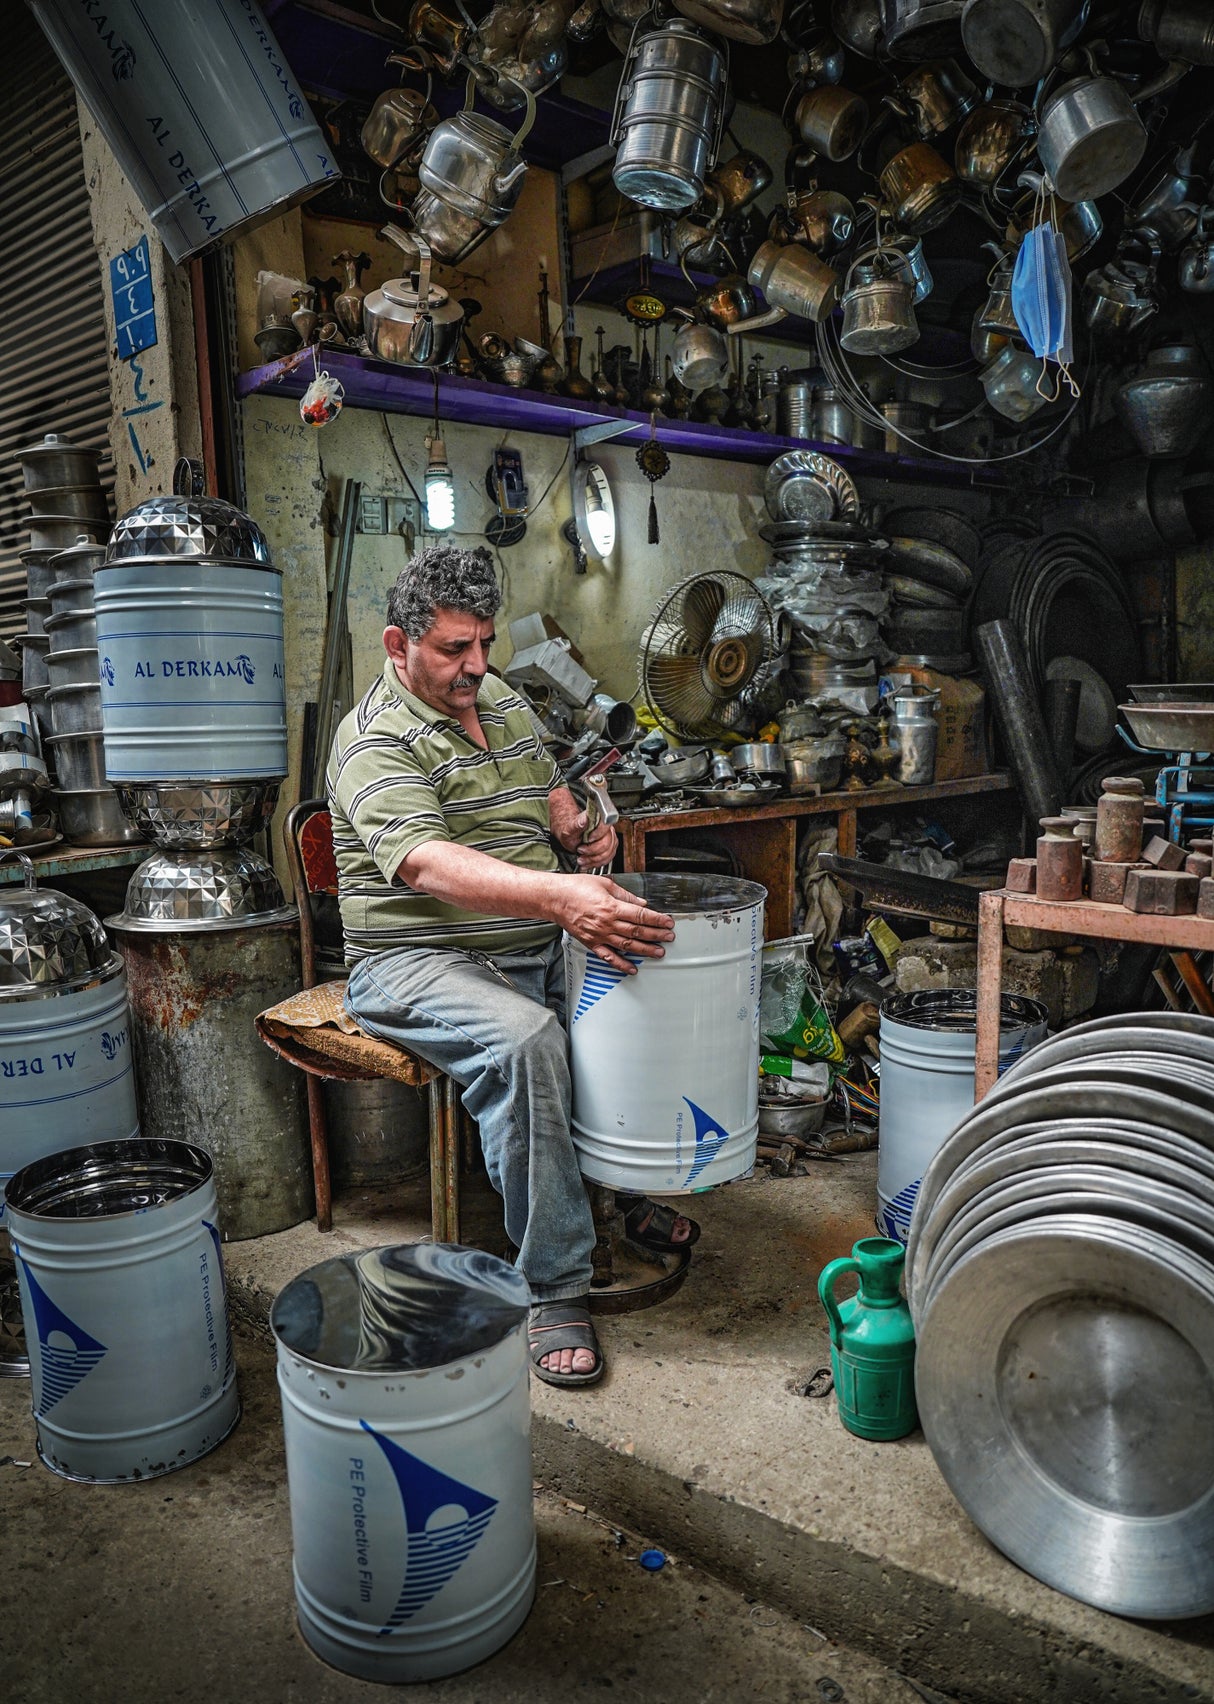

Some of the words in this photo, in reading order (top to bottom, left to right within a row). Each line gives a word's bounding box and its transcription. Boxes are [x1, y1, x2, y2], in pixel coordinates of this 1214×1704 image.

[146, 116, 171, 147] AL
[134, 662, 155, 678] AL
[161, 660, 243, 678] DERKAM
[51, 1050, 77, 1070] AL
[200, 1252, 208, 1274] PE
[202, 1276, 214, 1343] Protective
[209, 1343, 218, 1372] Film
[349, 1457, 365, 1482] PE
[352, 1485, 370, 1567] Protective
[358, 1569, 374, 1604] Film
